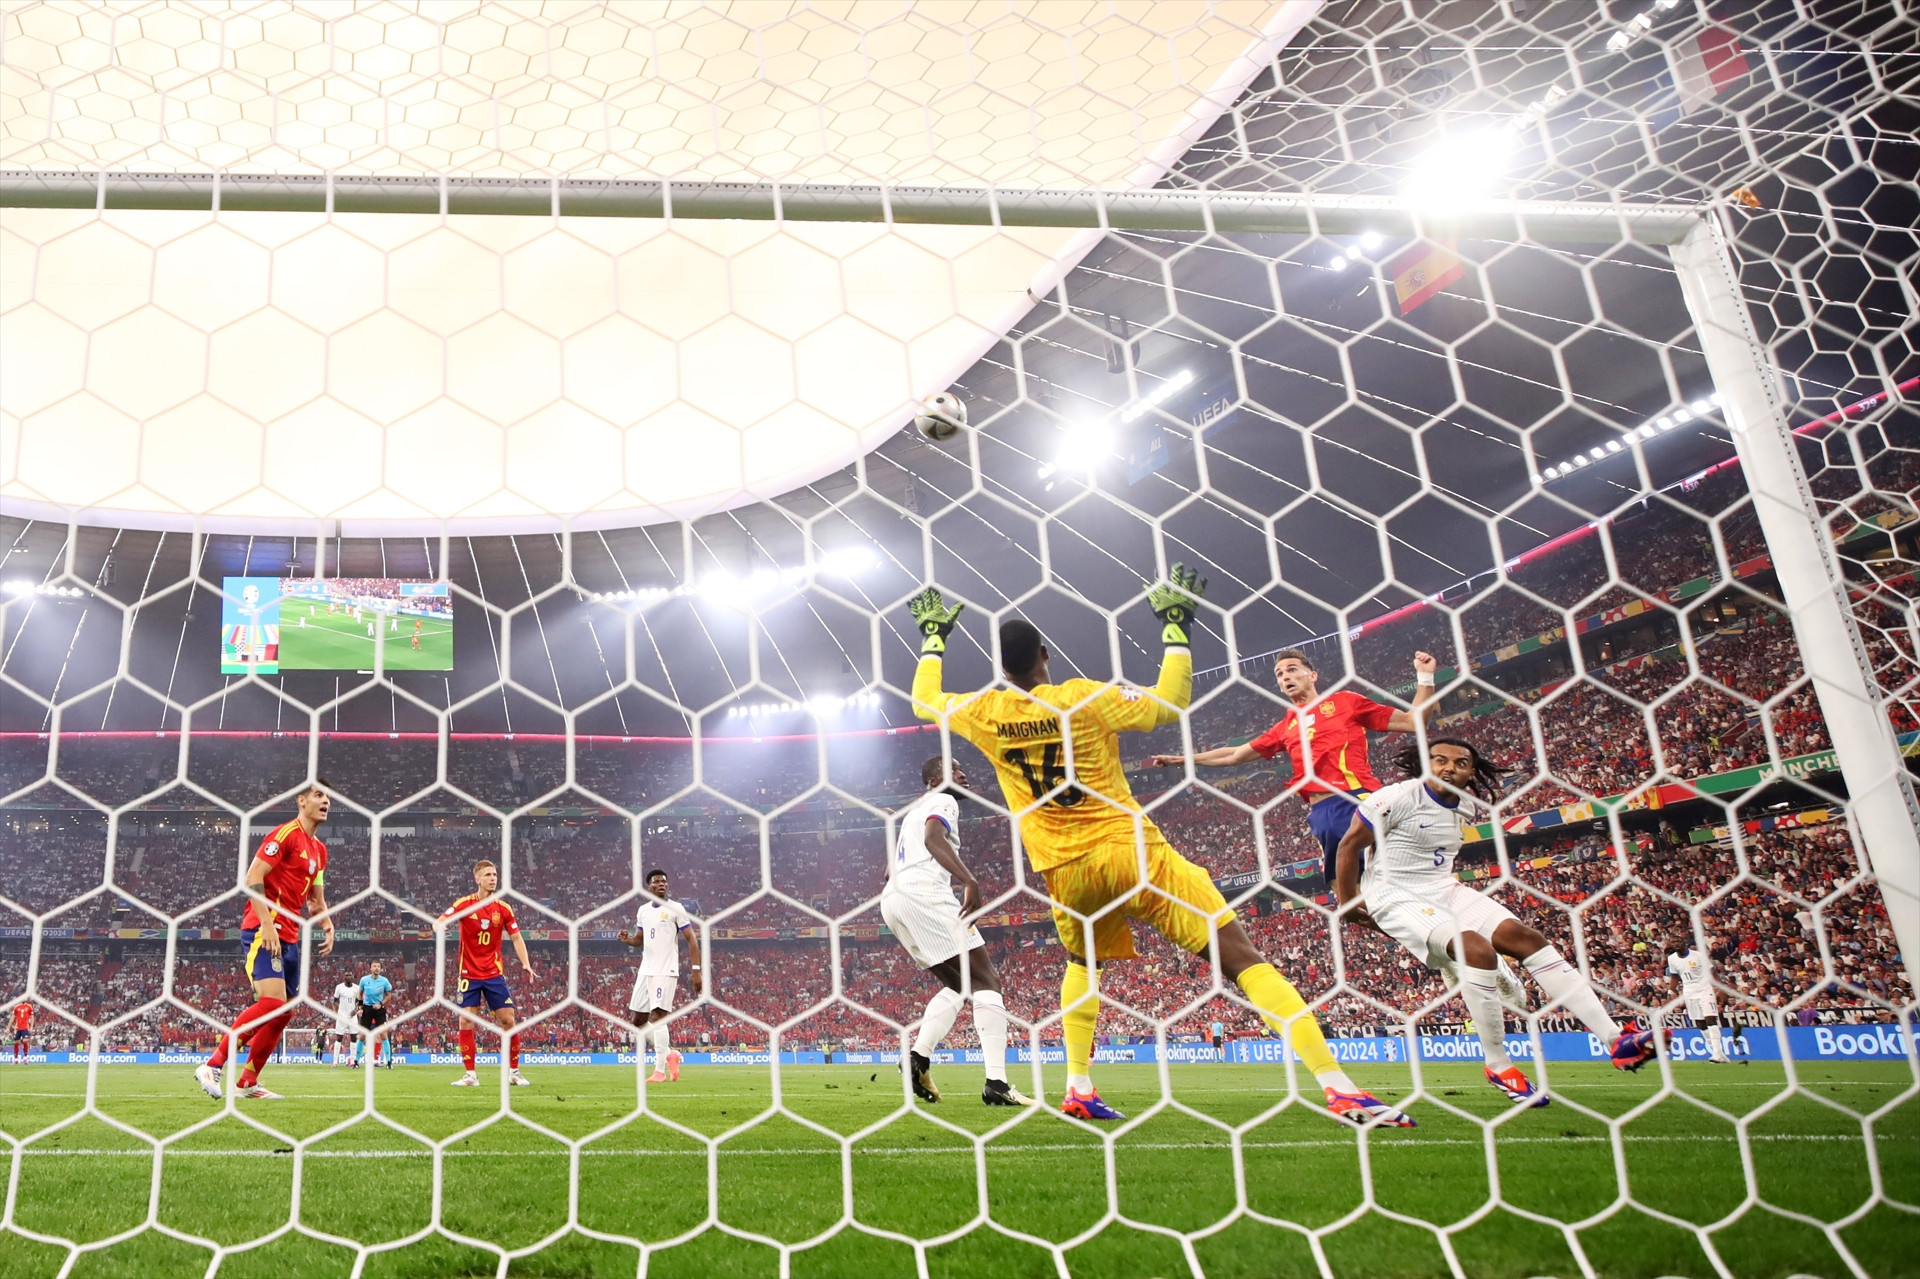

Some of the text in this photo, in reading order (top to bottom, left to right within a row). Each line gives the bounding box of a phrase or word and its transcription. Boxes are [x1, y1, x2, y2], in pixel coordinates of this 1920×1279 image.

[997, 718, 1059, 738] MAIGNAN
[1004, 744, 1087, 808] 16
[1434, 846, 1446, 867] 5
[301, 876, 311, 896] 7
[477, 931, 491, 945] 10
[650, 928, 656, 939] 8
[656, 987, 663, 998] 8
[524, 1054, 592, 1065] Booking.com
[846, 1053, 873, 1064] Booking.com
[1340, 1041, 1378, 1061] 2024
